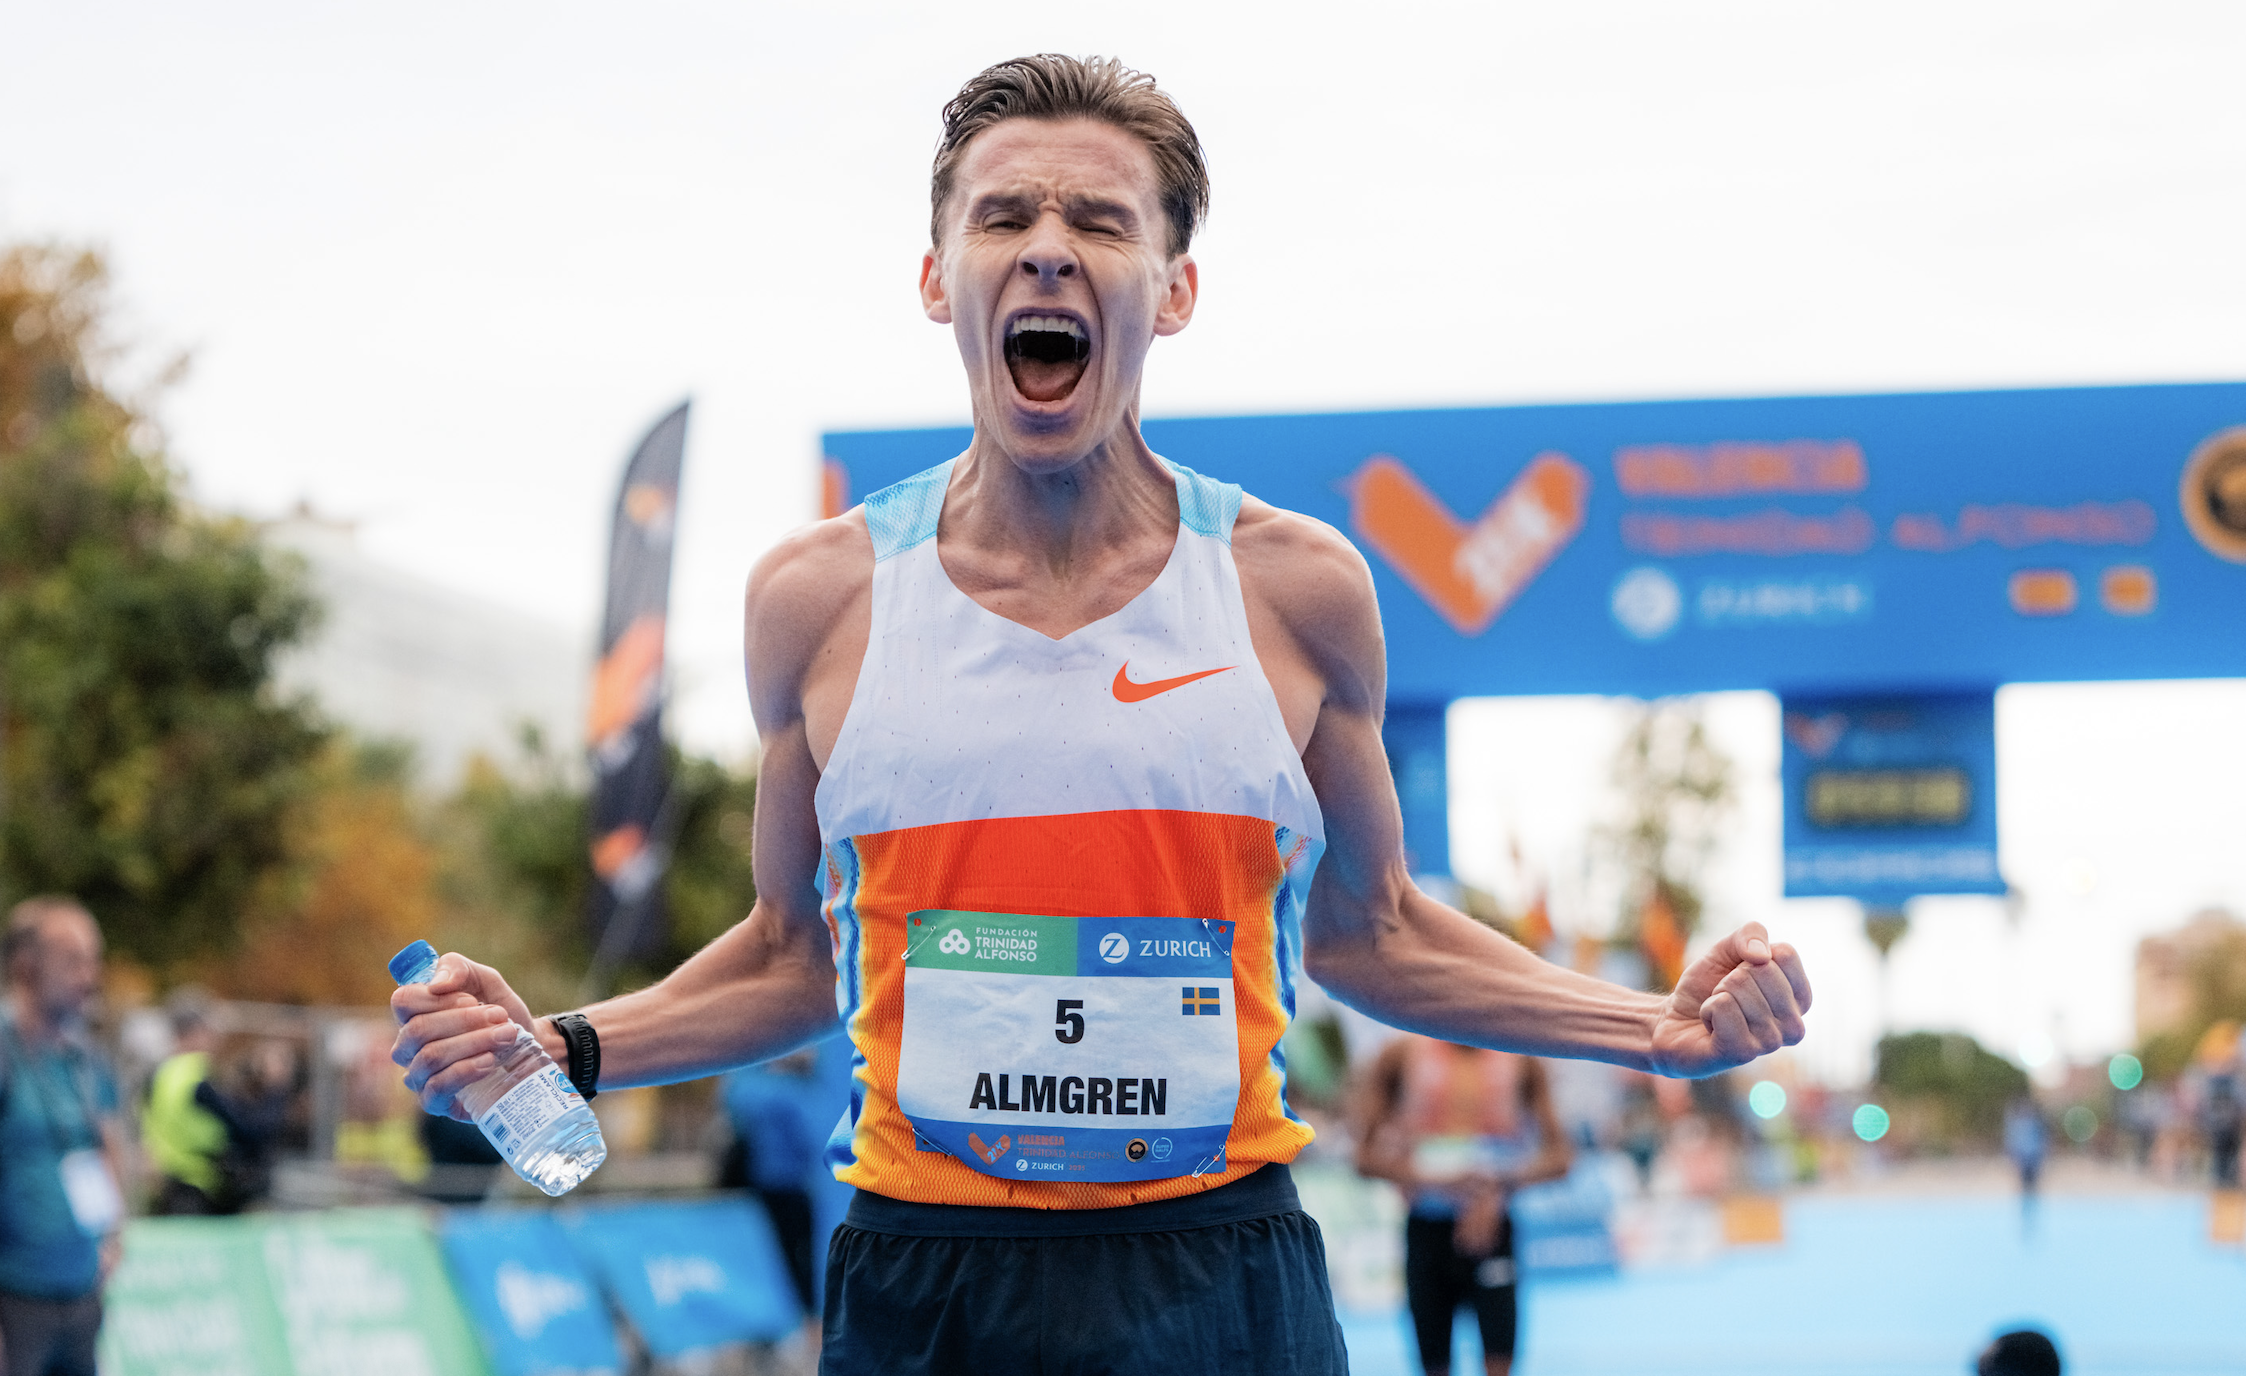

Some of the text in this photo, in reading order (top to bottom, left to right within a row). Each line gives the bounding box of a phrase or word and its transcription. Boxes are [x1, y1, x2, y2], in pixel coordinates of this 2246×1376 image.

[976, 927, 1037, 937] FUNDACIÓN
[975, 937, 1037, 950] TRINIDAD
[1140, 940, 1211, 957] ZURICH
[975, 949, 1037, 962] ALFONSO
[1055, 999, 1085, 1044] 5
[969, 1072, 1167, 1115] ALMGREN
[1018, 1135, 1065, 1146] VALENCIA
[1018, 1147, 1120, 1160] TRINIDAD ALFONSO
[1031, 1162, 1064, 1171] ZURICH
